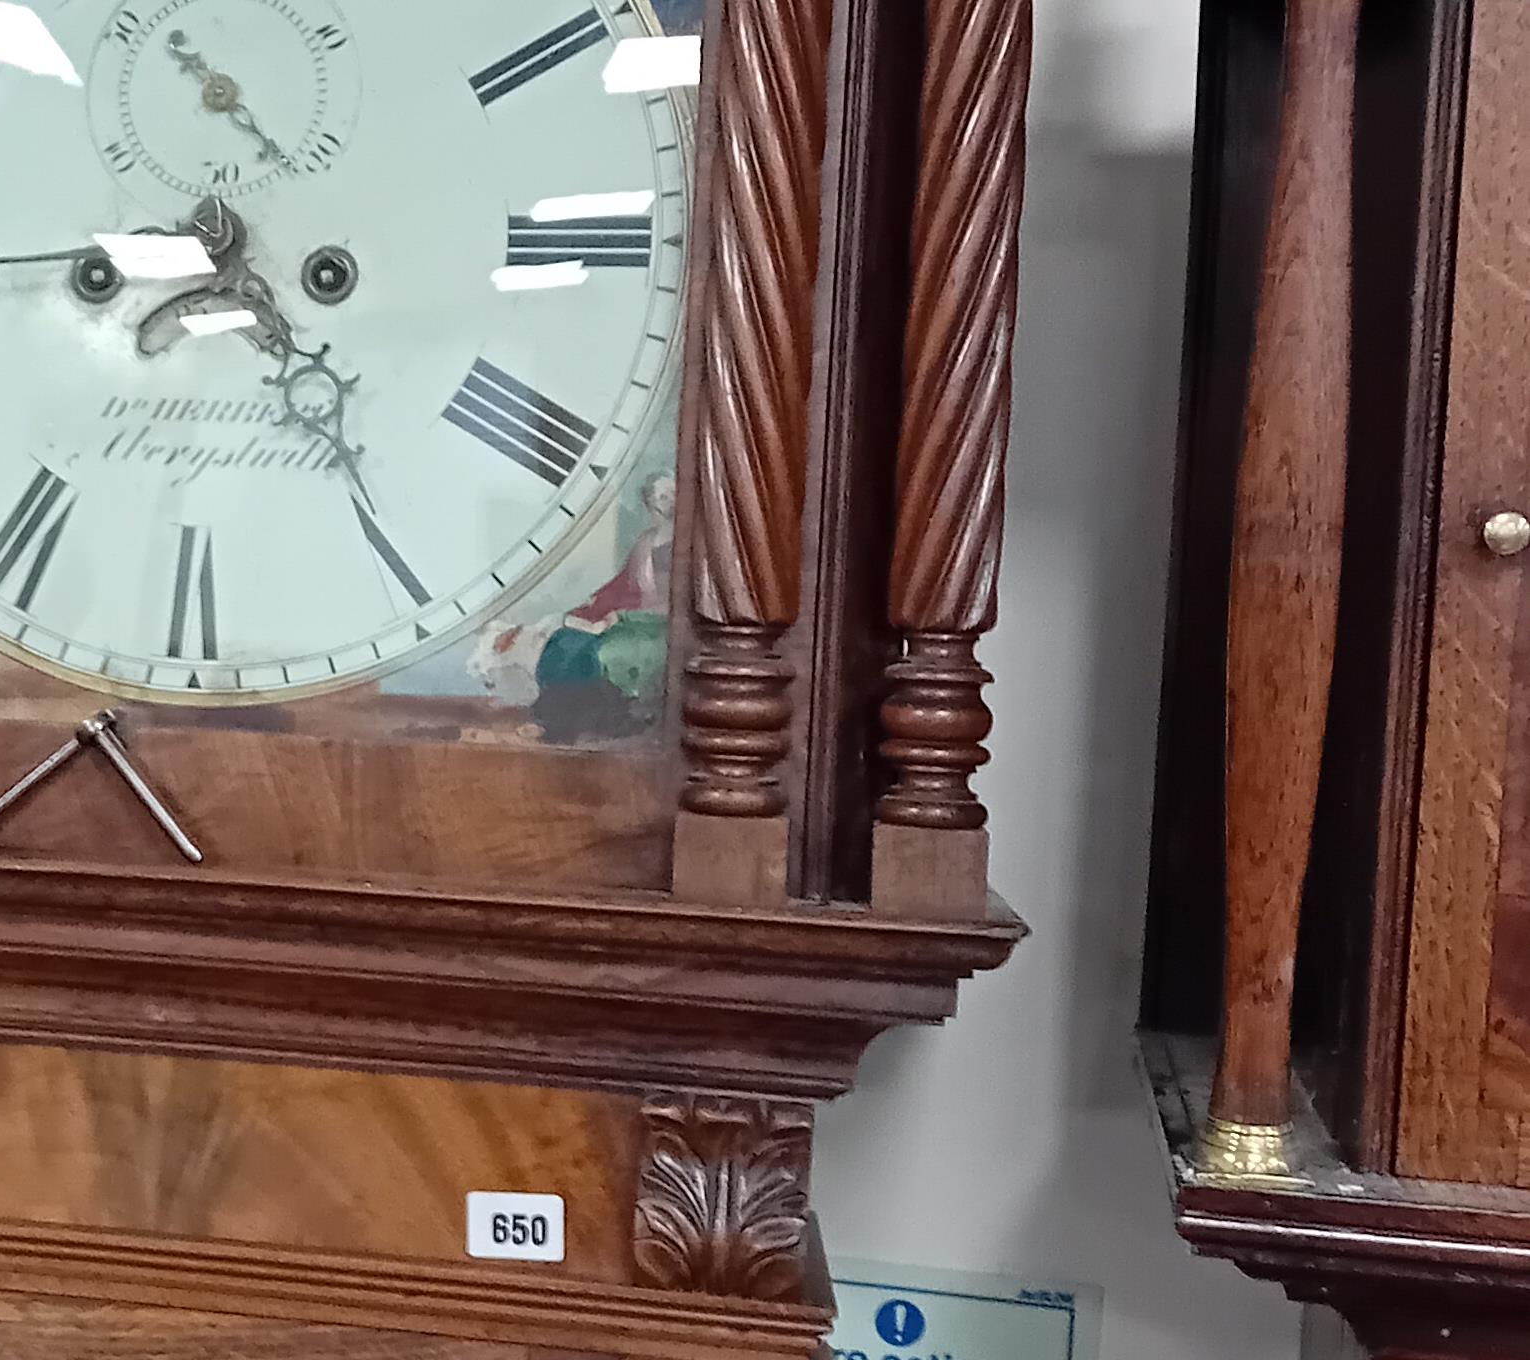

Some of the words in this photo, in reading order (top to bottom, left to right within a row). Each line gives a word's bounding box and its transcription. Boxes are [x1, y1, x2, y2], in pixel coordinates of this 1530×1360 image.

[467, 7, 612, 108] II
[506, 213, 653, 268] III
[440, 355, 600, 490] IIII
[165, 523, 222, 662] VI
[493, 1213, 549, 1246] 650
